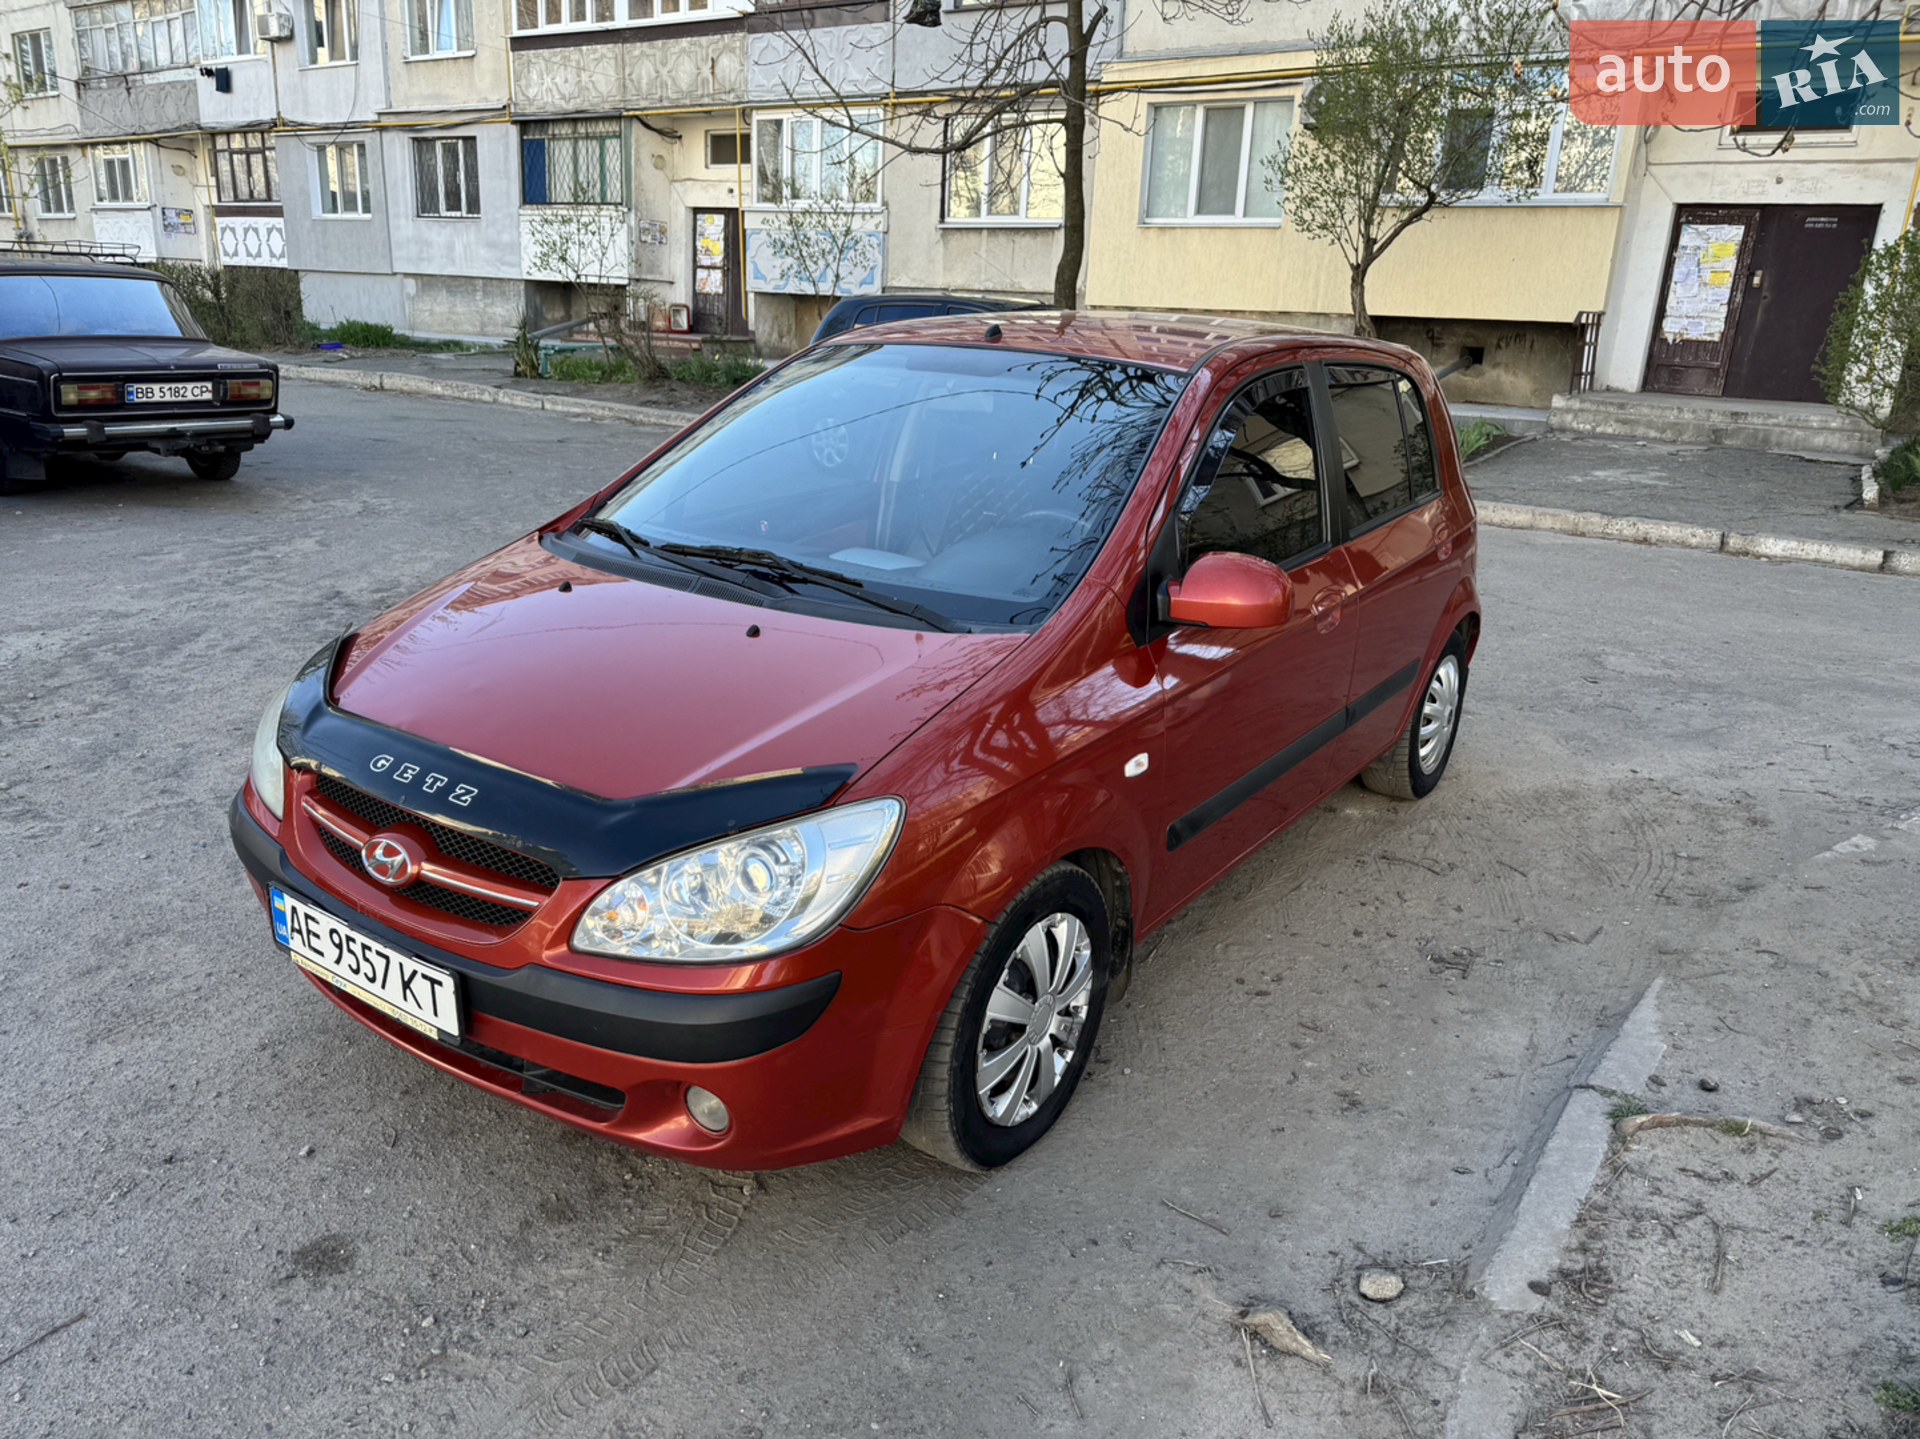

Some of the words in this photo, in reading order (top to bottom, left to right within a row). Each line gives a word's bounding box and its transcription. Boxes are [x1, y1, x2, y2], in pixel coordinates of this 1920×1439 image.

[136, 387, 155, 399] BB
[159, 386, 188, 399] 5182
[191, 385, 209, 398] CP
[369, 754, 478, 806] GETZ
[290, 905, 325, 958] AE
[329, 928, 391, 991] 9557
[398, 961, 444, 1018] KT
